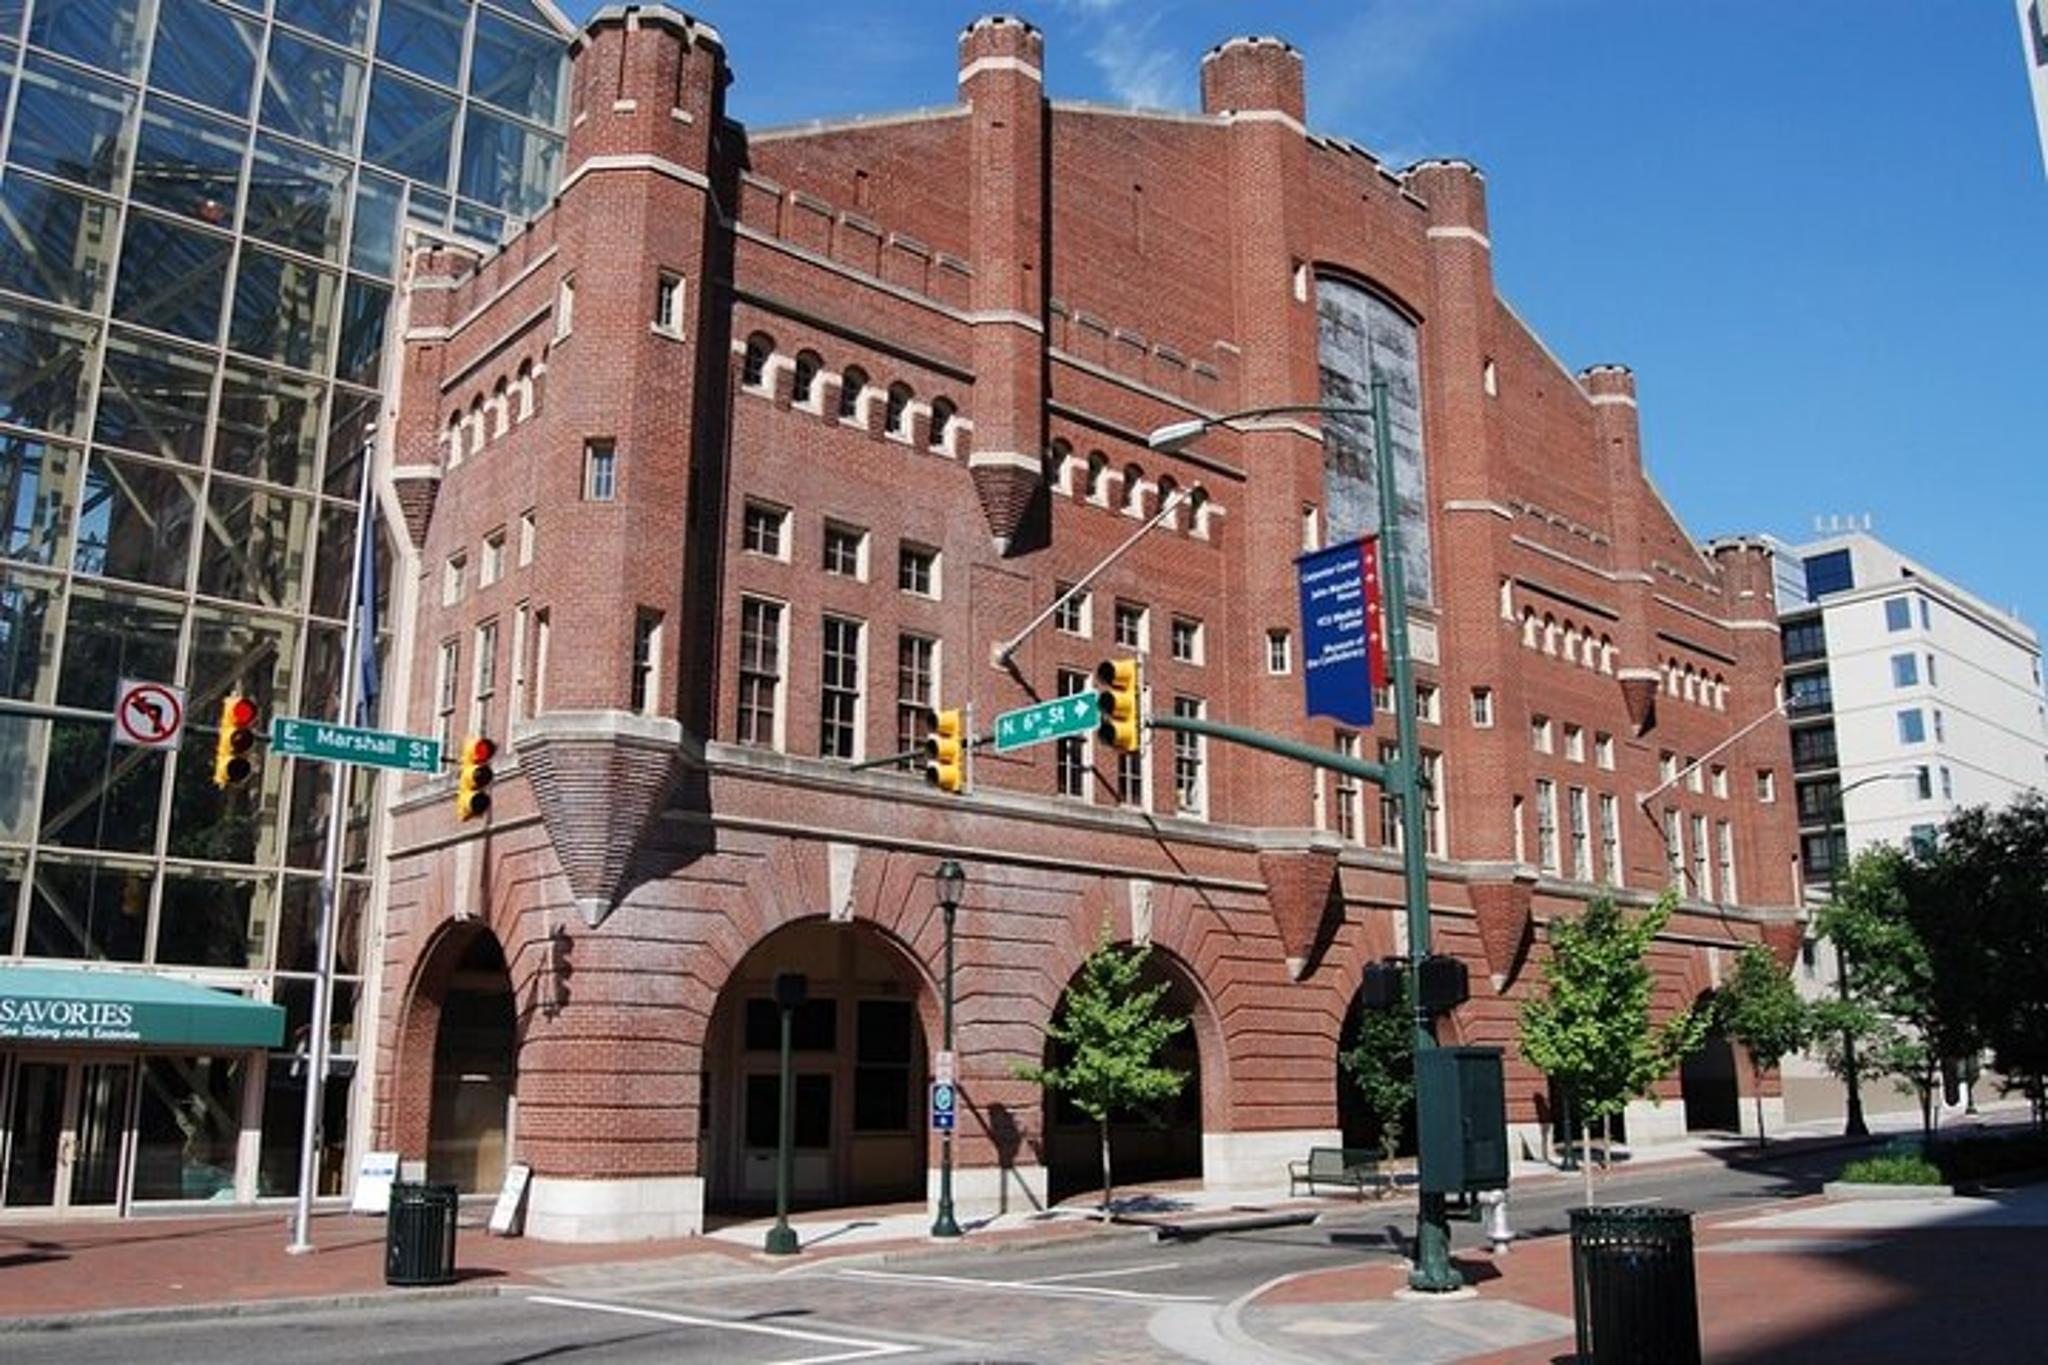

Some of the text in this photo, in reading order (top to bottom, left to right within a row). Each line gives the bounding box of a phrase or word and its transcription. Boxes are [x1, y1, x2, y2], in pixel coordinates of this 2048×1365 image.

[1336, 560, 1360, 572] Center
[1329, 577, 1361, 594] Marshall
[1333, 607, 1363, 622] Medical
[1340, 620, 1363, 631] Center
[1323, 639, 1355, 654] Museum
[1320, 648, 1366, 666] Confederacy
[1002, 719, 1014, 736] N
[1048, 705, 1065, 724] St
[316, 727, 396, 754] Marshall
[408, 741, 430, 760] St
[0, 998, 133, 1026] SAVORIES
